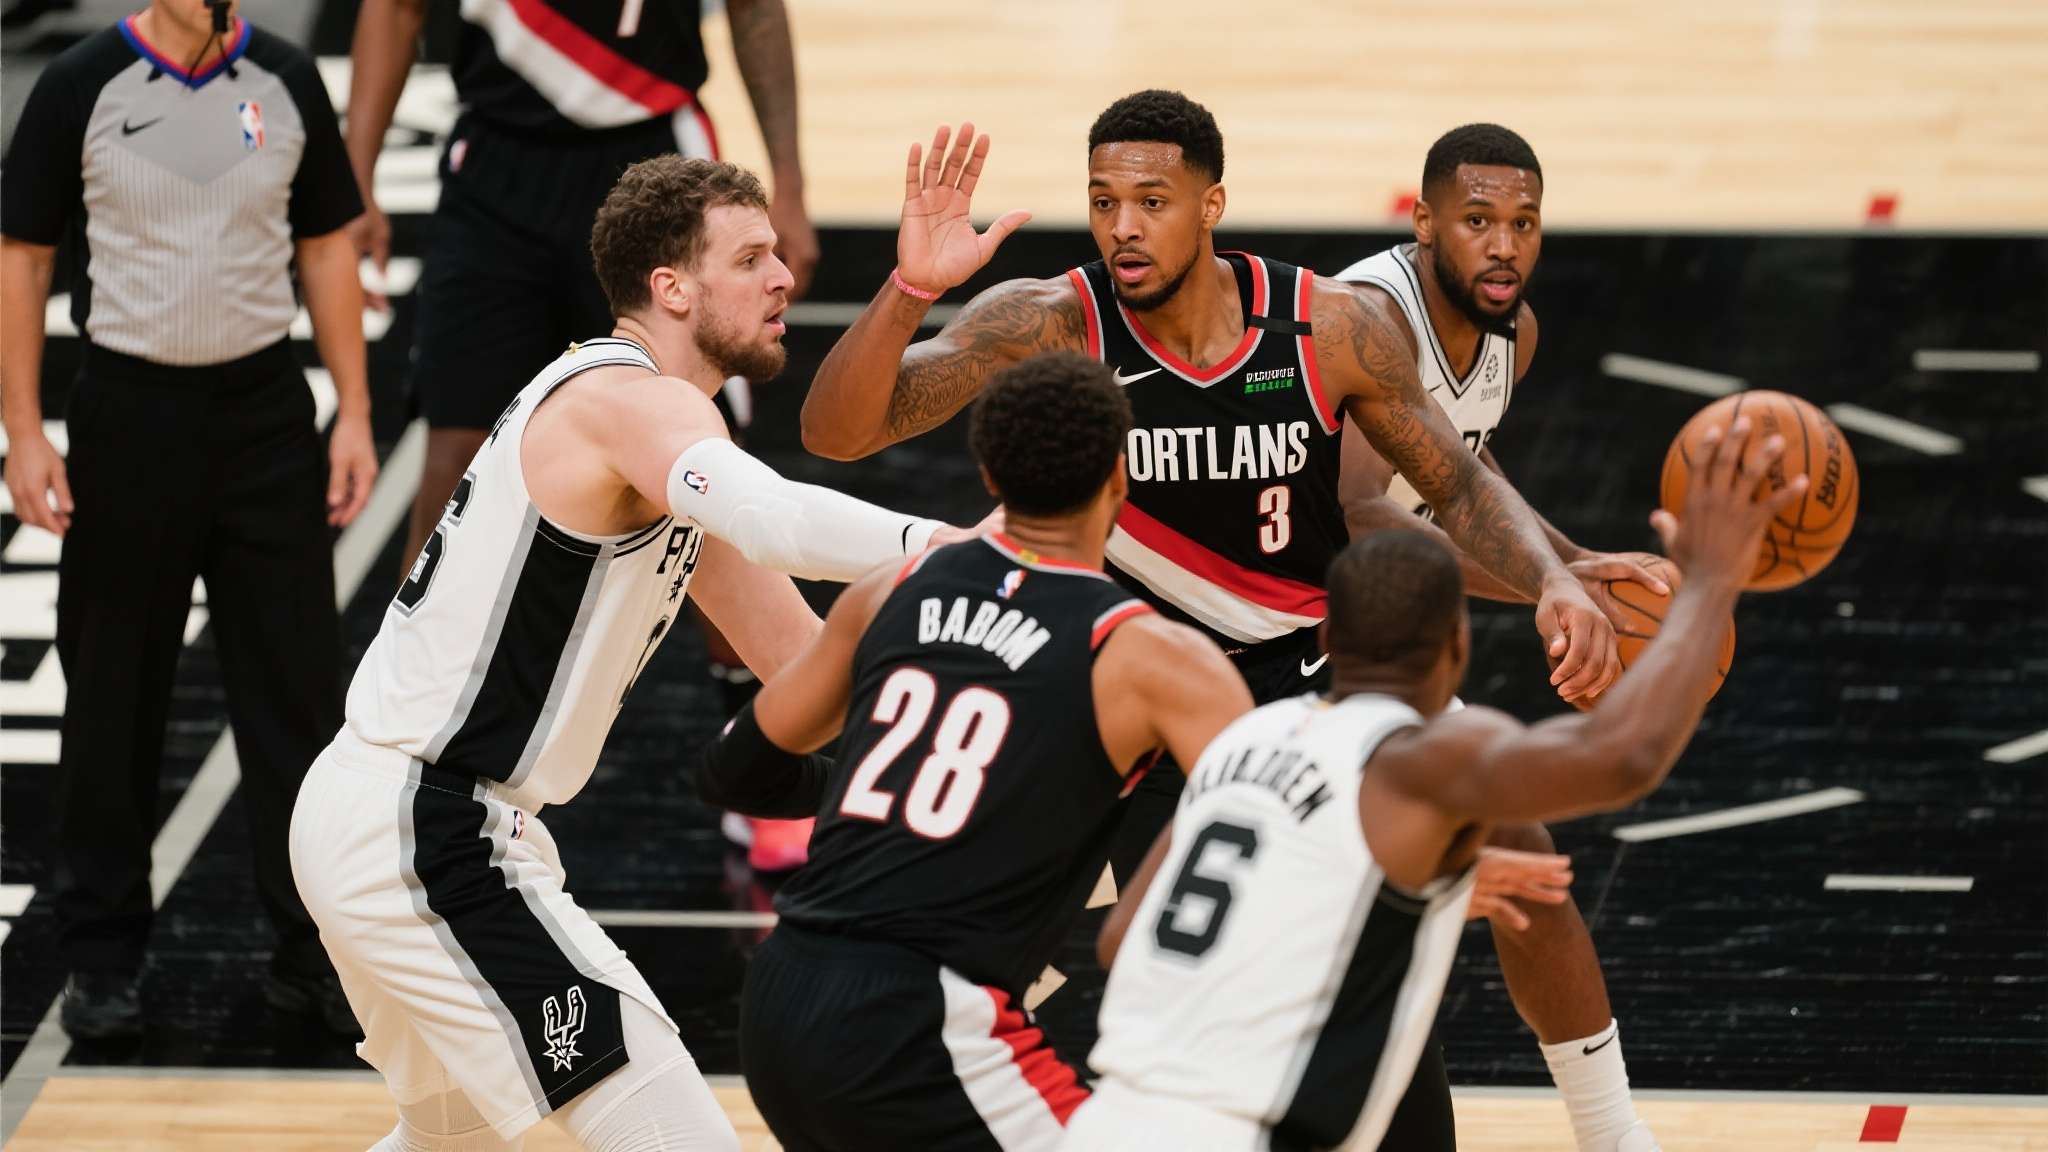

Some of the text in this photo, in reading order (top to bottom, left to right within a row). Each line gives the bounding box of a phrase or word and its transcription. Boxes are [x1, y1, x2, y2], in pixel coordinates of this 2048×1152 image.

[1127, 420, 1310, 482] ORTLANS
[1257, 483, 1292, 555] 3
[838, 665, 1013, 840] 28
[1154, 819, 1259, 958] 6
